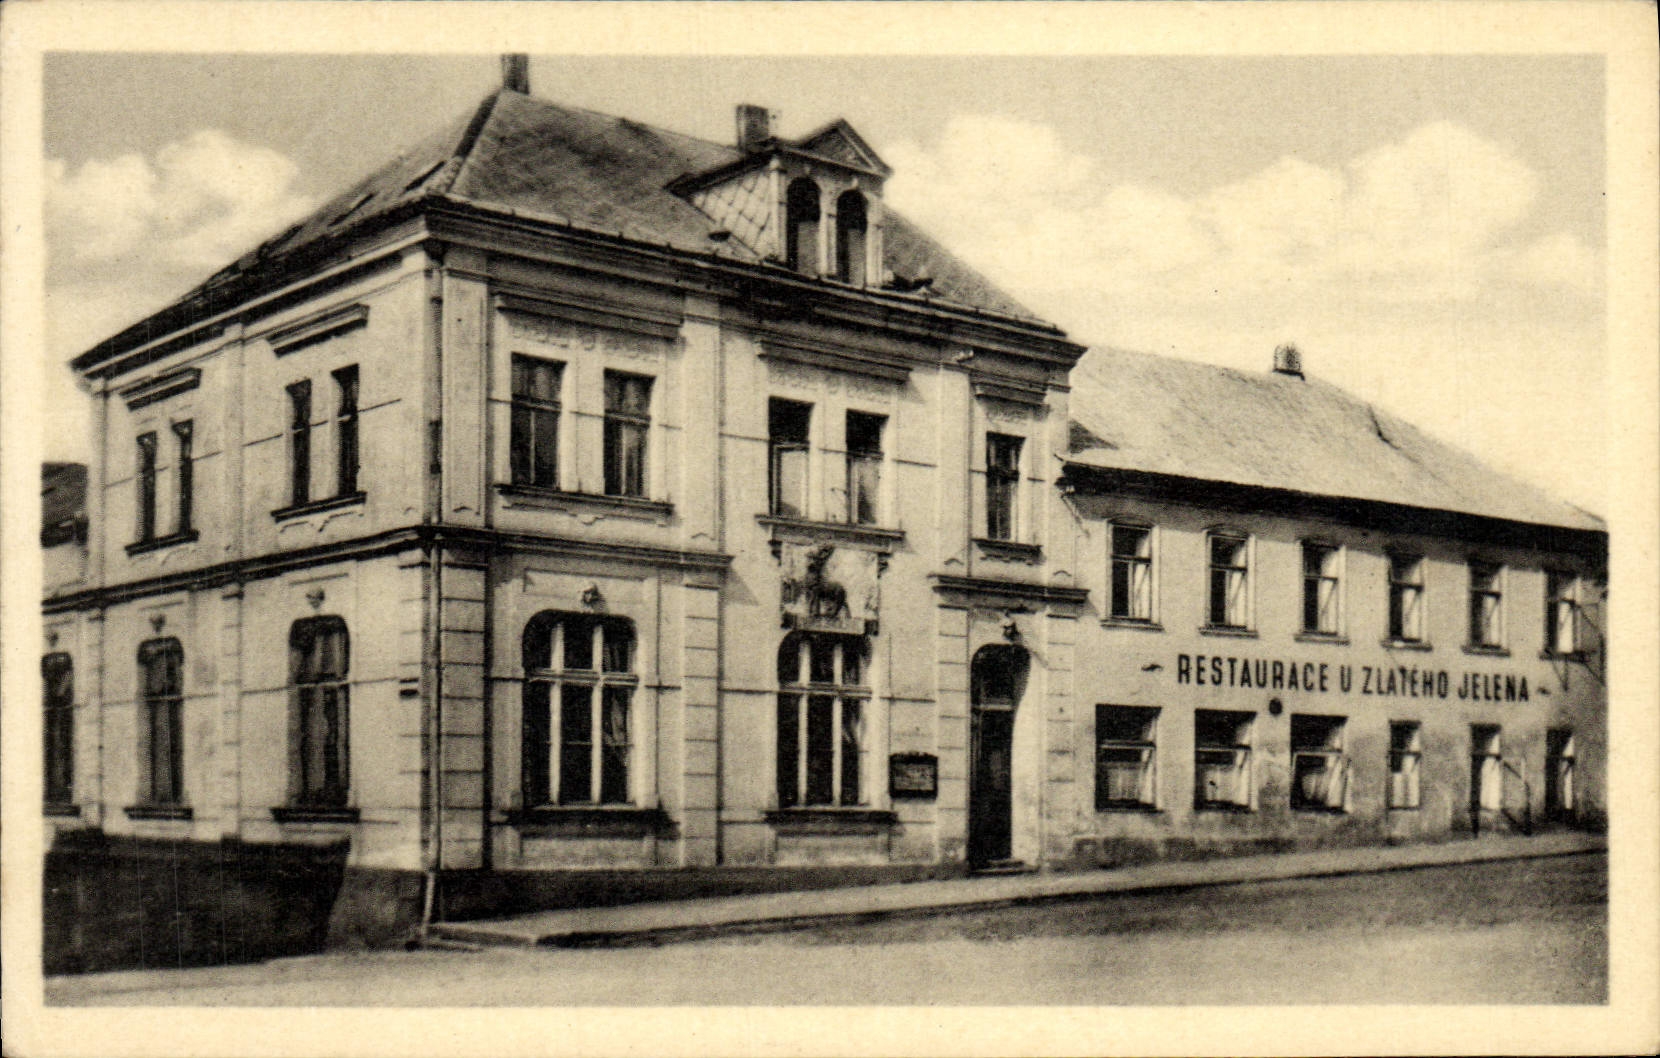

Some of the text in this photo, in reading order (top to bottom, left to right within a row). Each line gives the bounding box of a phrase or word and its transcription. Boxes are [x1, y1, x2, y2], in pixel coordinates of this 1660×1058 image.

[1178, 654, 1529, 702] RESTAURACE U ZLATÉHO JELENA
